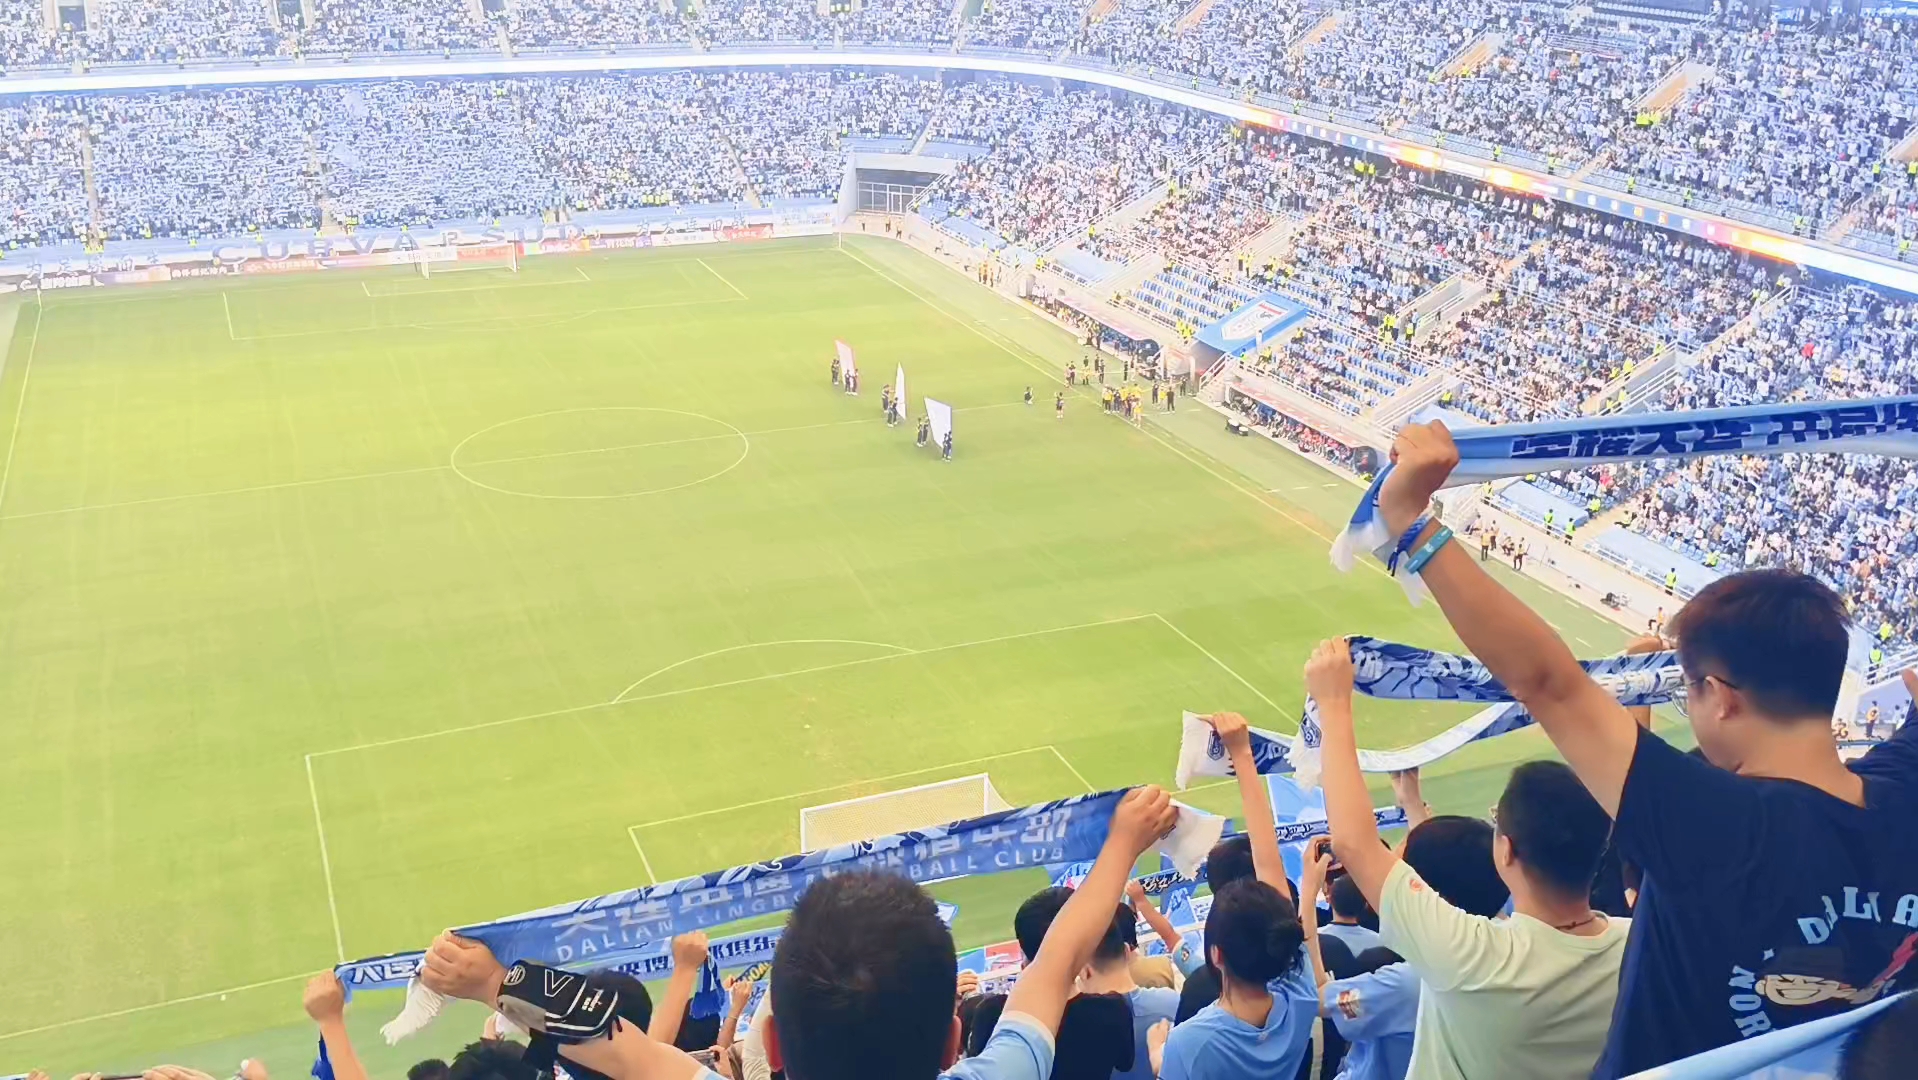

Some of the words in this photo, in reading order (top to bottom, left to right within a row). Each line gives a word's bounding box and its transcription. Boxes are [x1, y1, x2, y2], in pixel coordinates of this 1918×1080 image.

[556, 919, 674, 964] DALIAN
[994, 846, 1063, 868] CLUB
[1728, 965, 1776, 1038] NOR
